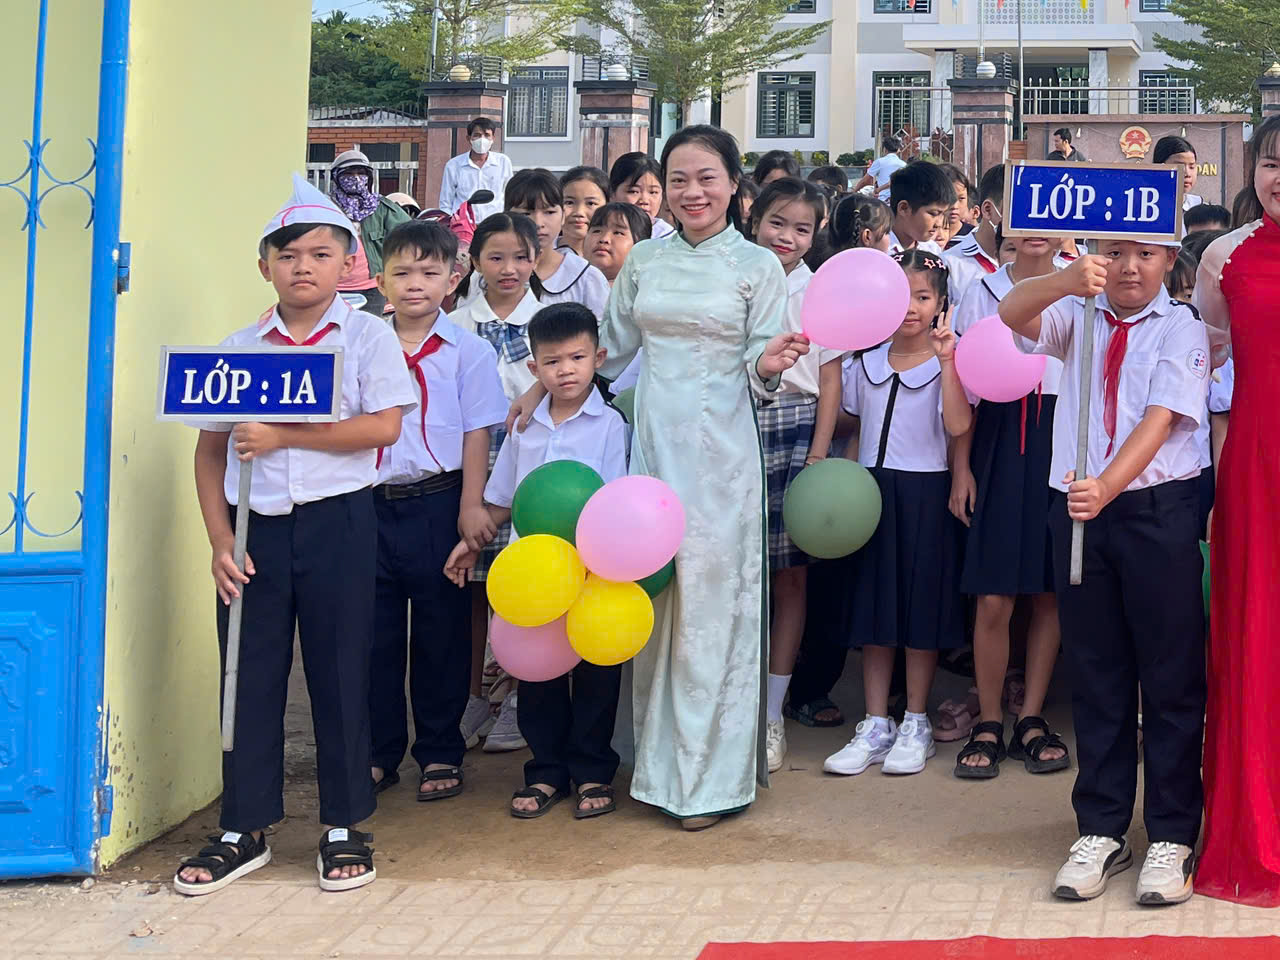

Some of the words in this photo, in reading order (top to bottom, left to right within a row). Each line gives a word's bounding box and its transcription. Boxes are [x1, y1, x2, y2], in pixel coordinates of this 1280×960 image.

[1027, 173, 1096, 220] LỚP
[1123, 187, 1160, 222] 1B
[180, 358, 252, 405] LỚP
[278, 369, 317, 404] 1A
